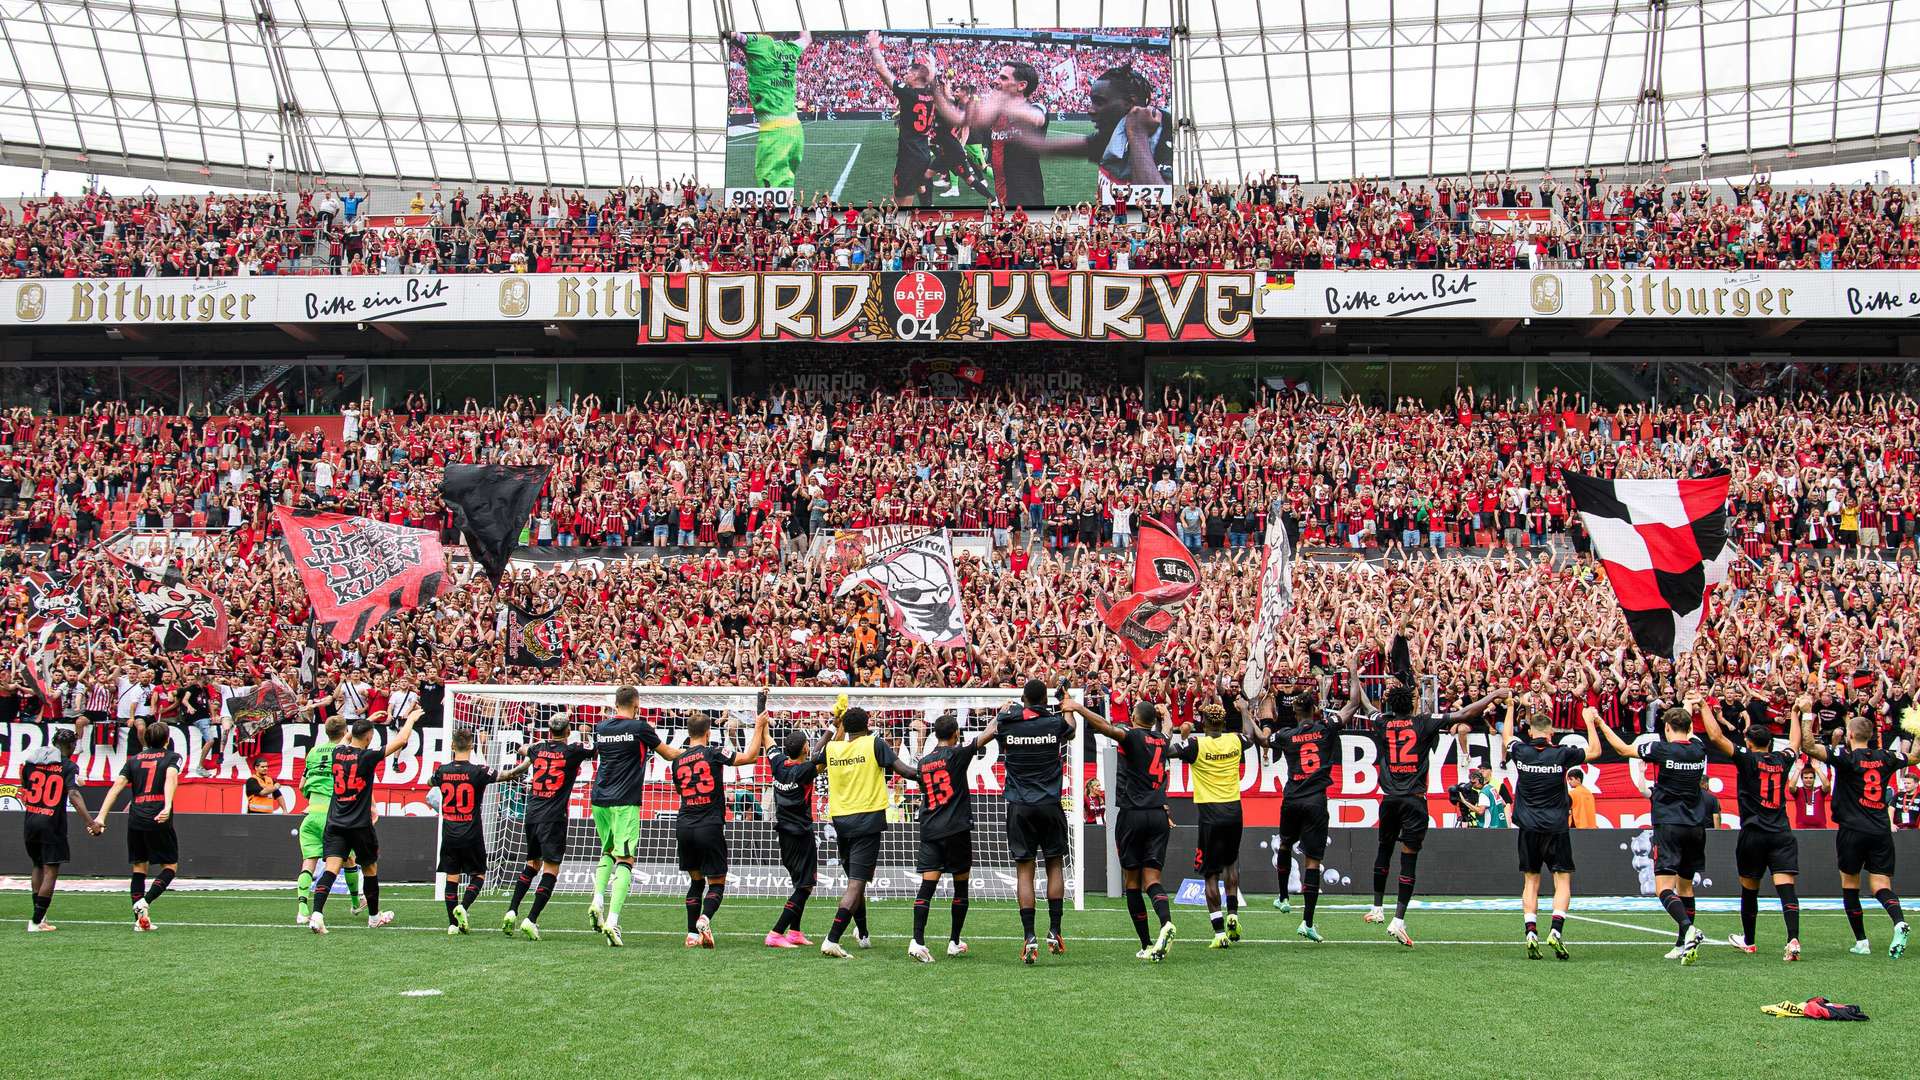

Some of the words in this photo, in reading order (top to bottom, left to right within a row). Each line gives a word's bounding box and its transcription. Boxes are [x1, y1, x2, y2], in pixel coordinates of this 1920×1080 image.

[68, 281, 257, 322] Bitburger
[305, 292, 355, 320] Bitte
[362, 293, 402, 309] ein
[406, 278, 449, 302] Bit
[649, 273, 872, 340] NORD
[896, 291, 943, 300] BAYER
[915, 273, 925, 318] BAYER
[973, 272, 1253, 339] KURVE
[1325, 287, 1380, 314] Bitte
[1386, 286, 1428, 303] ein
[1432, 273, 1477, 298] Bit
[1589, 273, 1794, 317] Bitburger
[1847, 287, 1902, 316] Bitte
[896, 313, 940, 340] 04
[793, 373, 831, 390] WIR
[831, 370, 866, 390] FÜR
[1006, 734, 1057, 745] Barmenia
[1205, 748, 1240, 761] Barmenia
[1386, 729, 1418, 763] 12
[533, 757, 566, 791] 25
[829, 755, 866, 768] Barmenia
[1148, 746, 1164, 783] 4
[1300, 743, 1320, 774] 6
[1517, 761, 1563, 774] Barmenia
[27, 770, 64, 808] 30
[141, 760, 158, 793] 7
[333, 763, 366, 796] 34
[676, 761, 715, 798] 23
[922, 769, 954, 810] 13
[1759, 773, 1781, 807] 11
[1863, 769, 1882, 801] 8
[441, 783, 475, 813] 20
[563, 870, 600, 888] triv
[650, 869, 691, 888] triv
